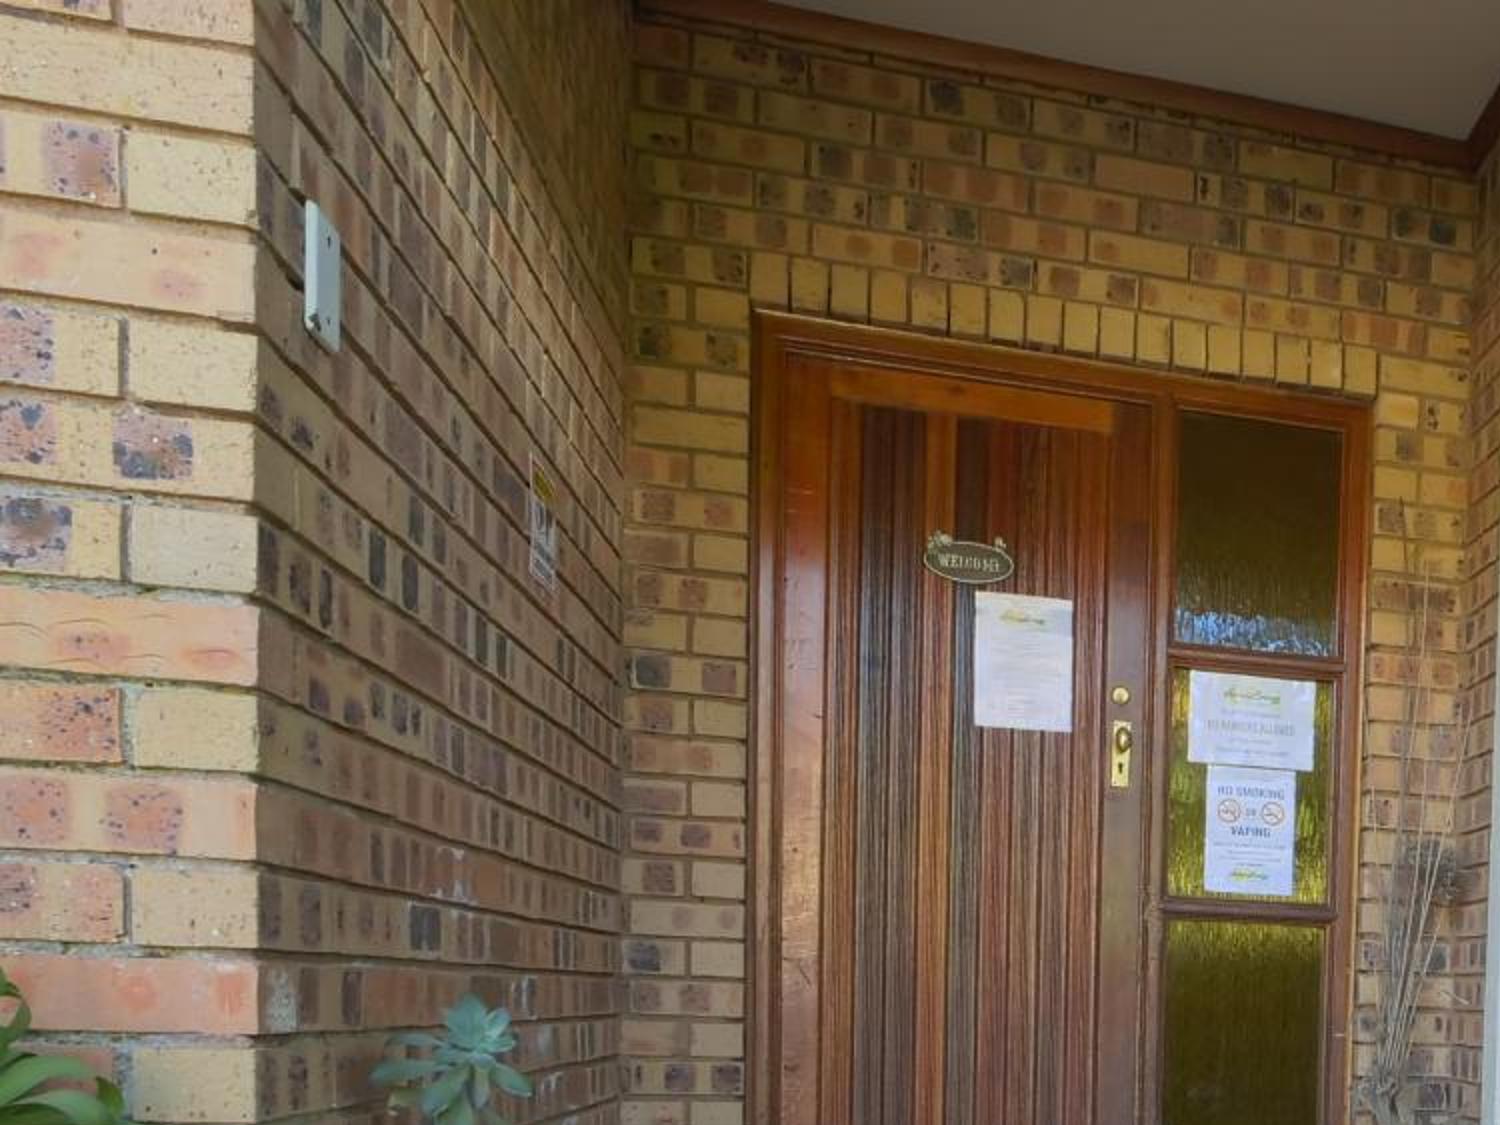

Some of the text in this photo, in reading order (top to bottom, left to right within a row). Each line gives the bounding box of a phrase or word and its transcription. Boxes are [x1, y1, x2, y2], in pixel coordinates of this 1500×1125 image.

[938, 553, 1000, 573] WELCOME
[1217, 785, 1286, 800] NO SMOKING
[1230, 825, 1272, 838] VAPING
